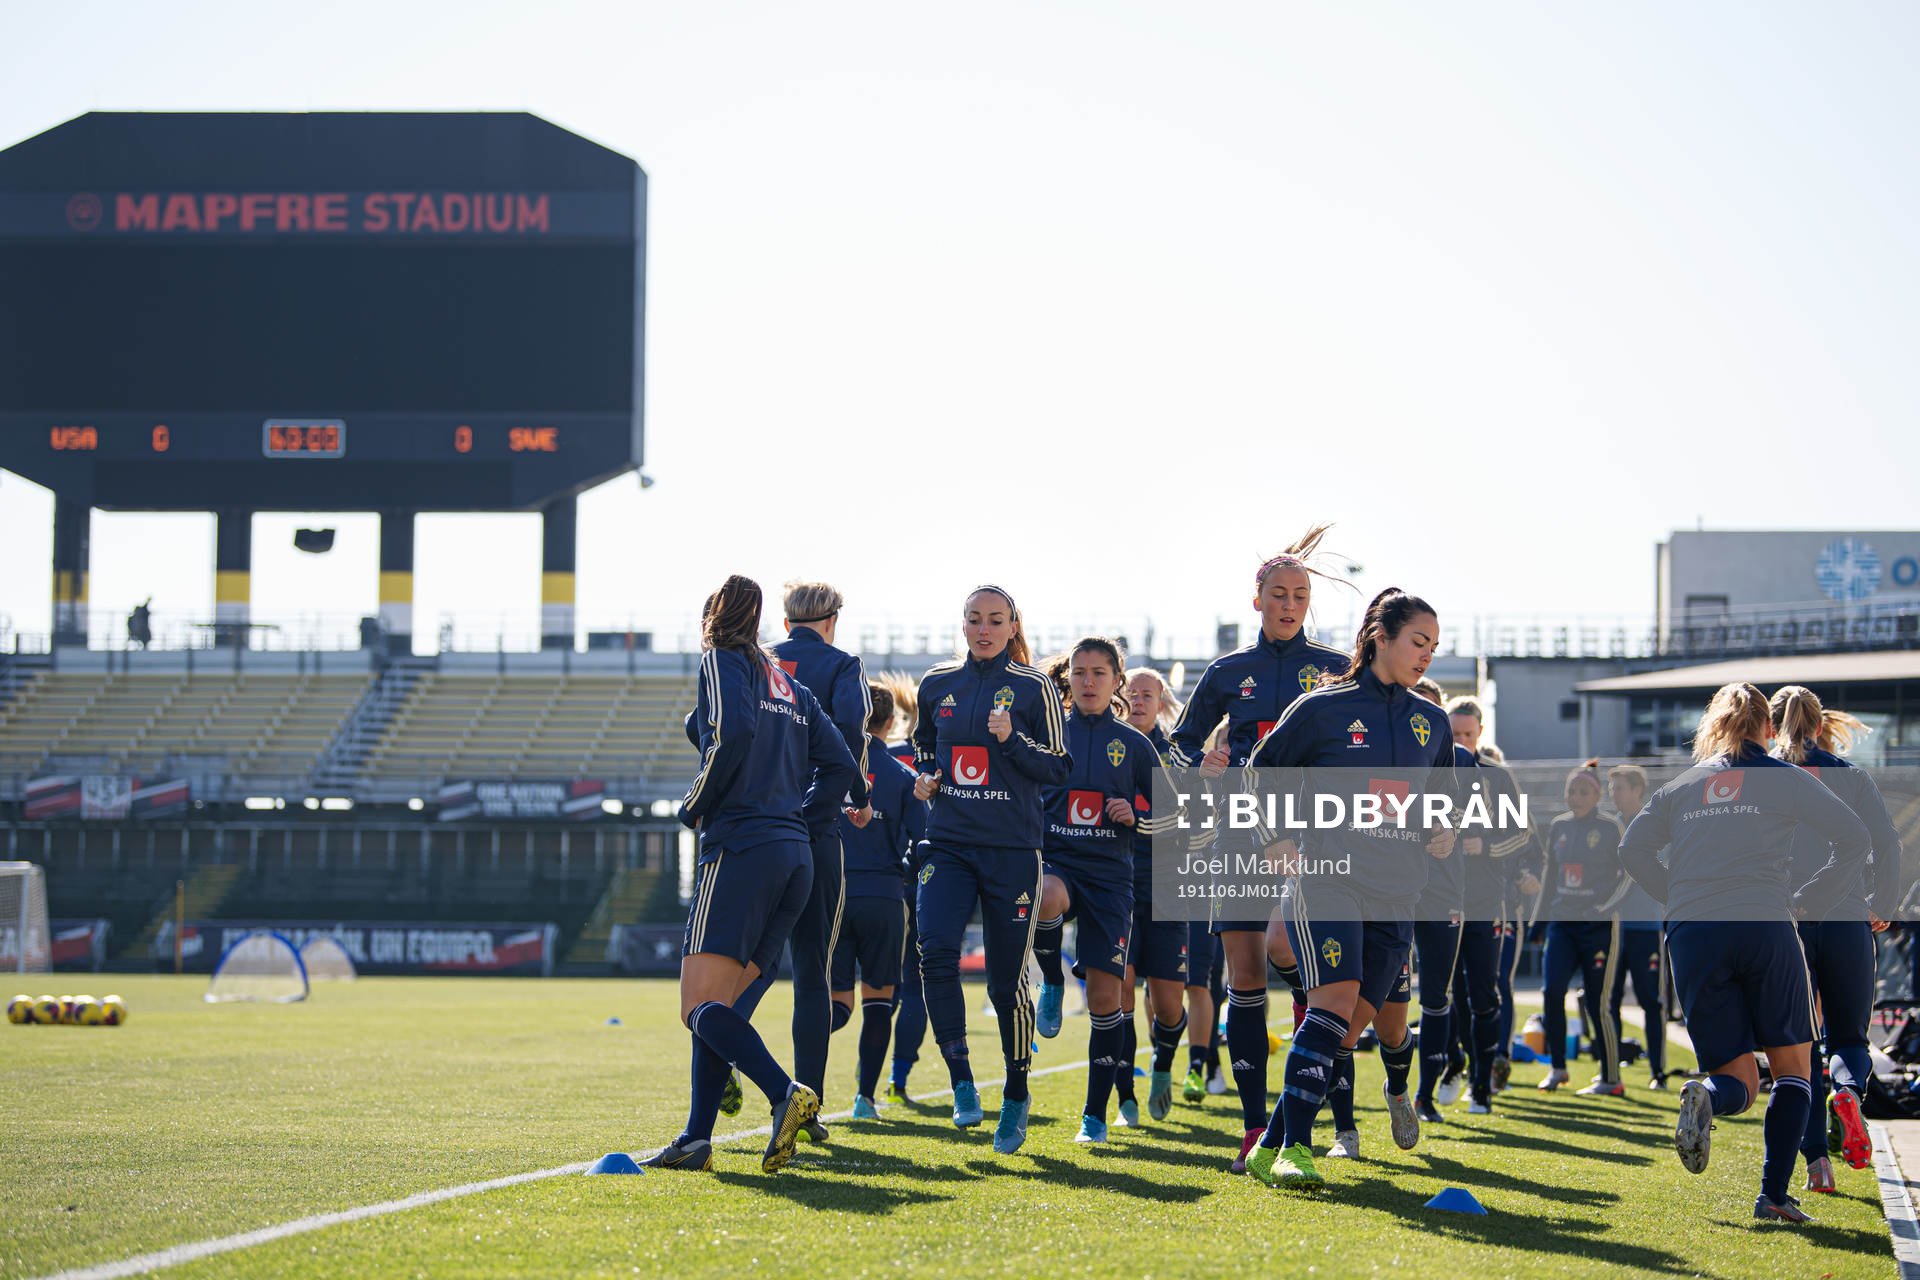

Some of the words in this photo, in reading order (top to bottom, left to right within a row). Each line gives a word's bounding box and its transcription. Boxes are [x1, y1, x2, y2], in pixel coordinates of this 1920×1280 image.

[115, 193, 348, 232] MAPFRE
[363, 193, 550, 232] STADIUM
[51, 426, 98, 450] USA
[509, 427, 558, 452] SWE
[760, 700, 792, 717] SVENSKA
[940, 784, 980, 799] SVENSKA
[984, 790, 1011, 800] SPEL
[1683, 805, 1730, 821] SVENSKA
[1733, 805, 1760, 815] SPEL
[1050, 824, 1092, 836] SVENSKA
[1095, 828, 1117, 838] SPEL
[1401, 830, 1420, 842] SPEL
